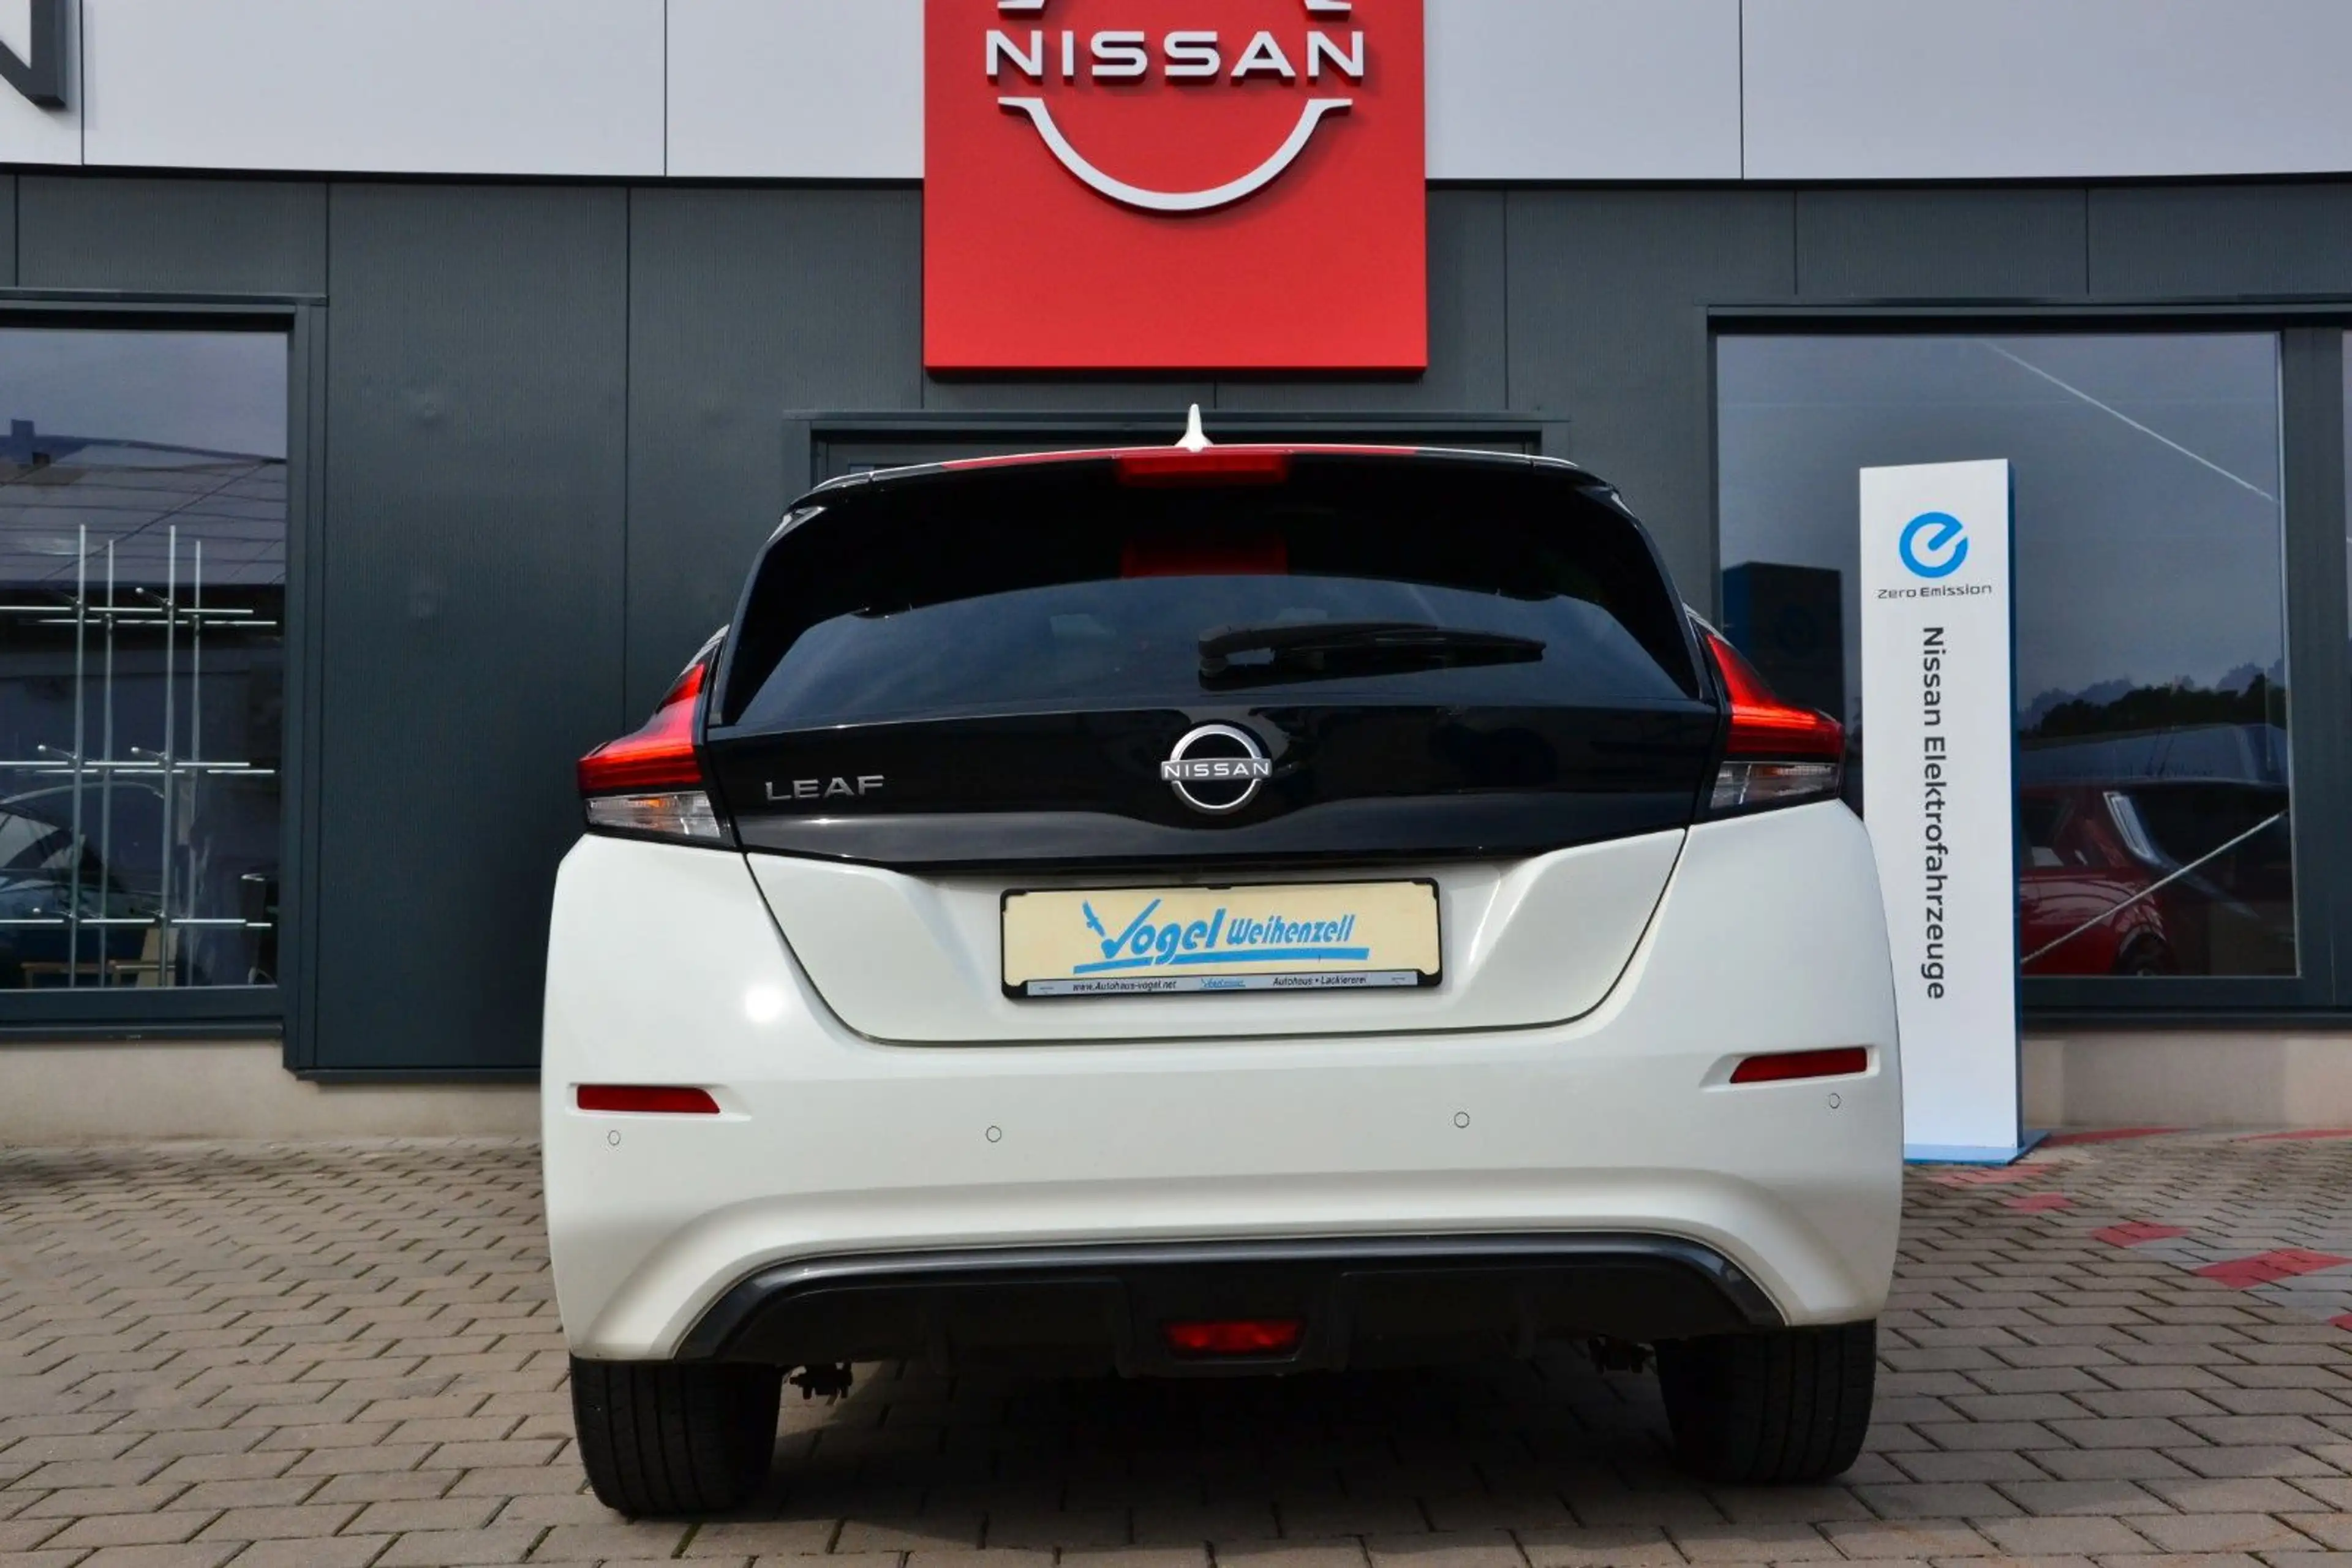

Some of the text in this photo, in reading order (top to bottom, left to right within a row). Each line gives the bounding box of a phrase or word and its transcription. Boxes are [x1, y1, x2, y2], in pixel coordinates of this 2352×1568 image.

[986, 29, 1365, 78] NISSAN
[1877, 584, 1992, 599] Zero Emission
[1164, 759, 1272, 778] NISSAN
[764, 774, 885, 802] LEAF
[1921, 627, 1948, 1000] Nissan Elektrofahrzeuge
[1082, 899, 1356, 963] Vogel Weihenzell
[1273, 976, 1313, 986] Autohaus
